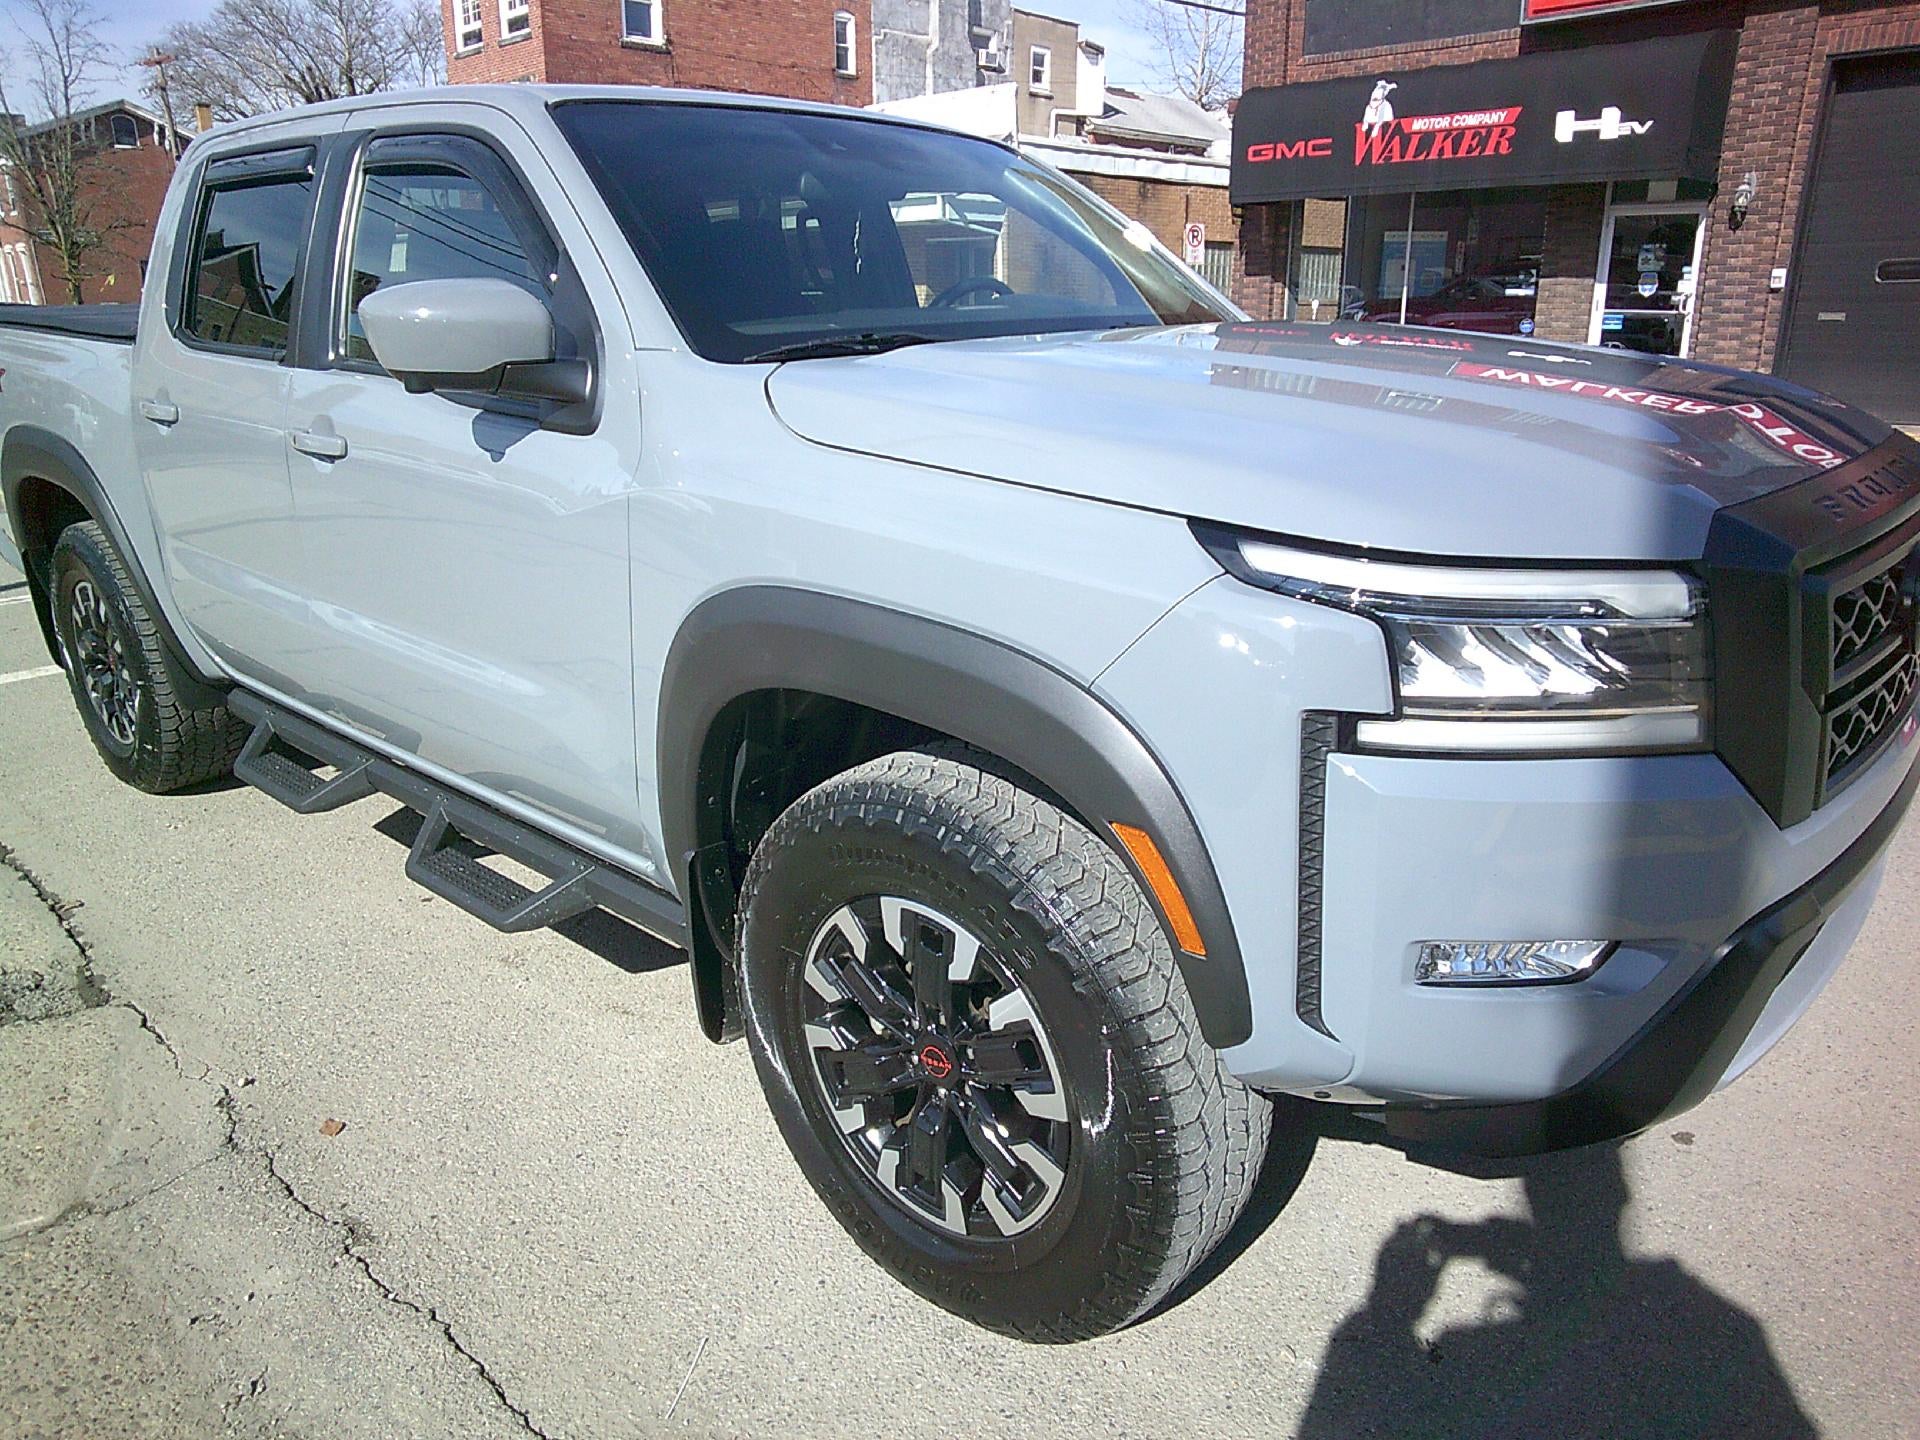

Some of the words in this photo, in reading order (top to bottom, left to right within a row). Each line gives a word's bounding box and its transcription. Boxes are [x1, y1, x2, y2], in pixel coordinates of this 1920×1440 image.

[1411, 114, 1450, 131] MOTOR
[1452, 110, 1508, 127] COMPANY
[1247, 137, 1333, 162] GMC
[1354, 118, 1517, 166] WALKER
